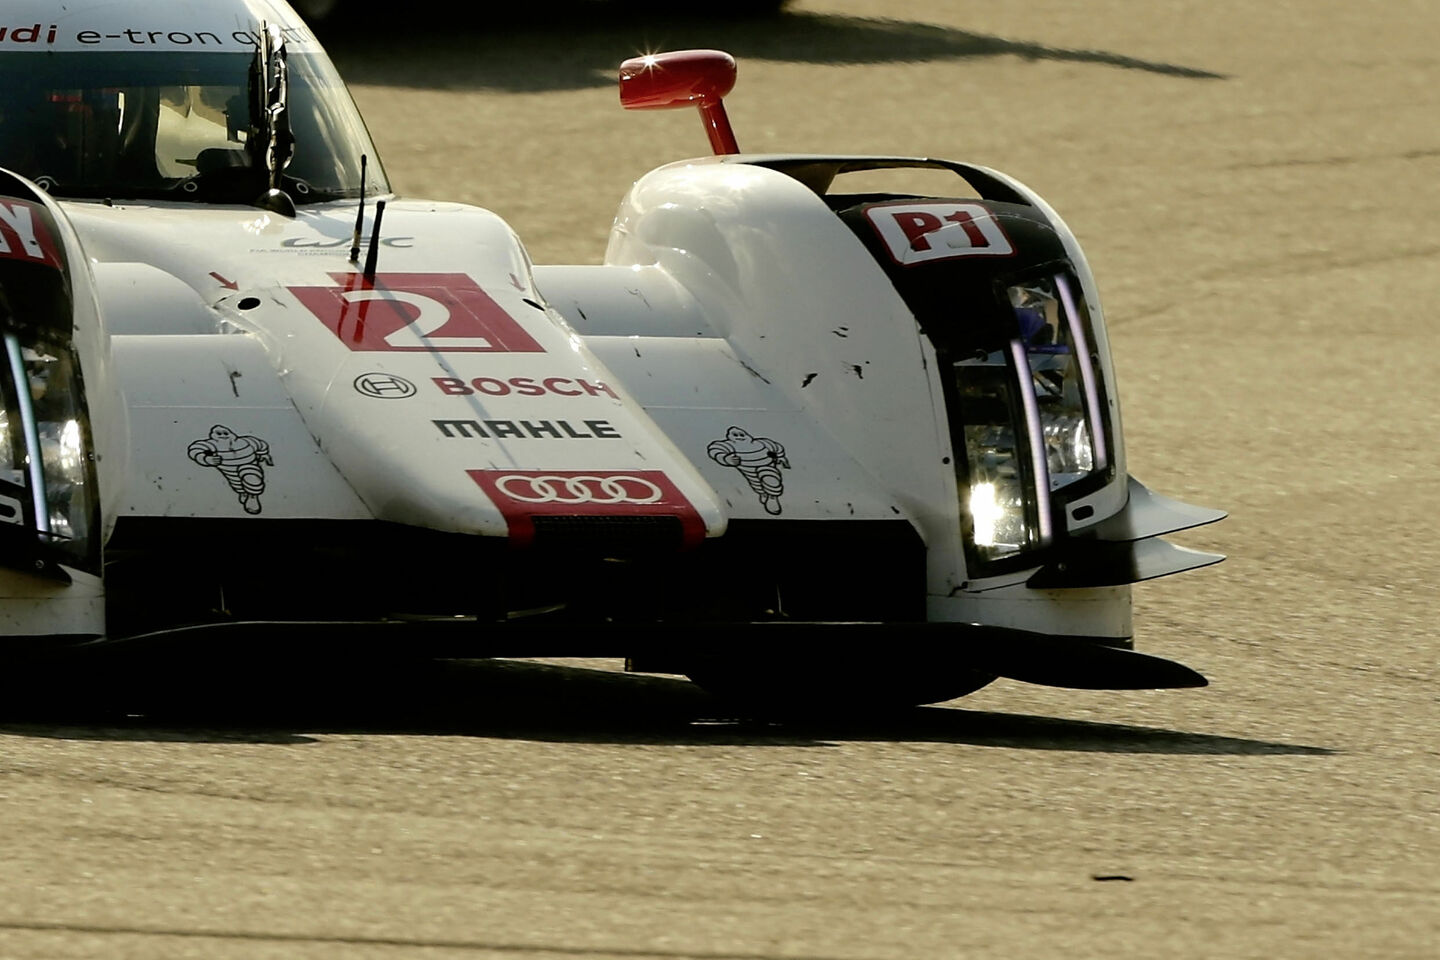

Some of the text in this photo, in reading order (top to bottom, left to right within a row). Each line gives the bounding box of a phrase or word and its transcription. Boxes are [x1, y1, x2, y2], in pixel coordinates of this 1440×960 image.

[76, 27, 223, 45] e-tron
[892, 210, 991, 252] P1
[341, 289, 493, 348] 2
[430, 376, 621, 400] BOSCH
[430, 419, 623, 439] MAHLE
